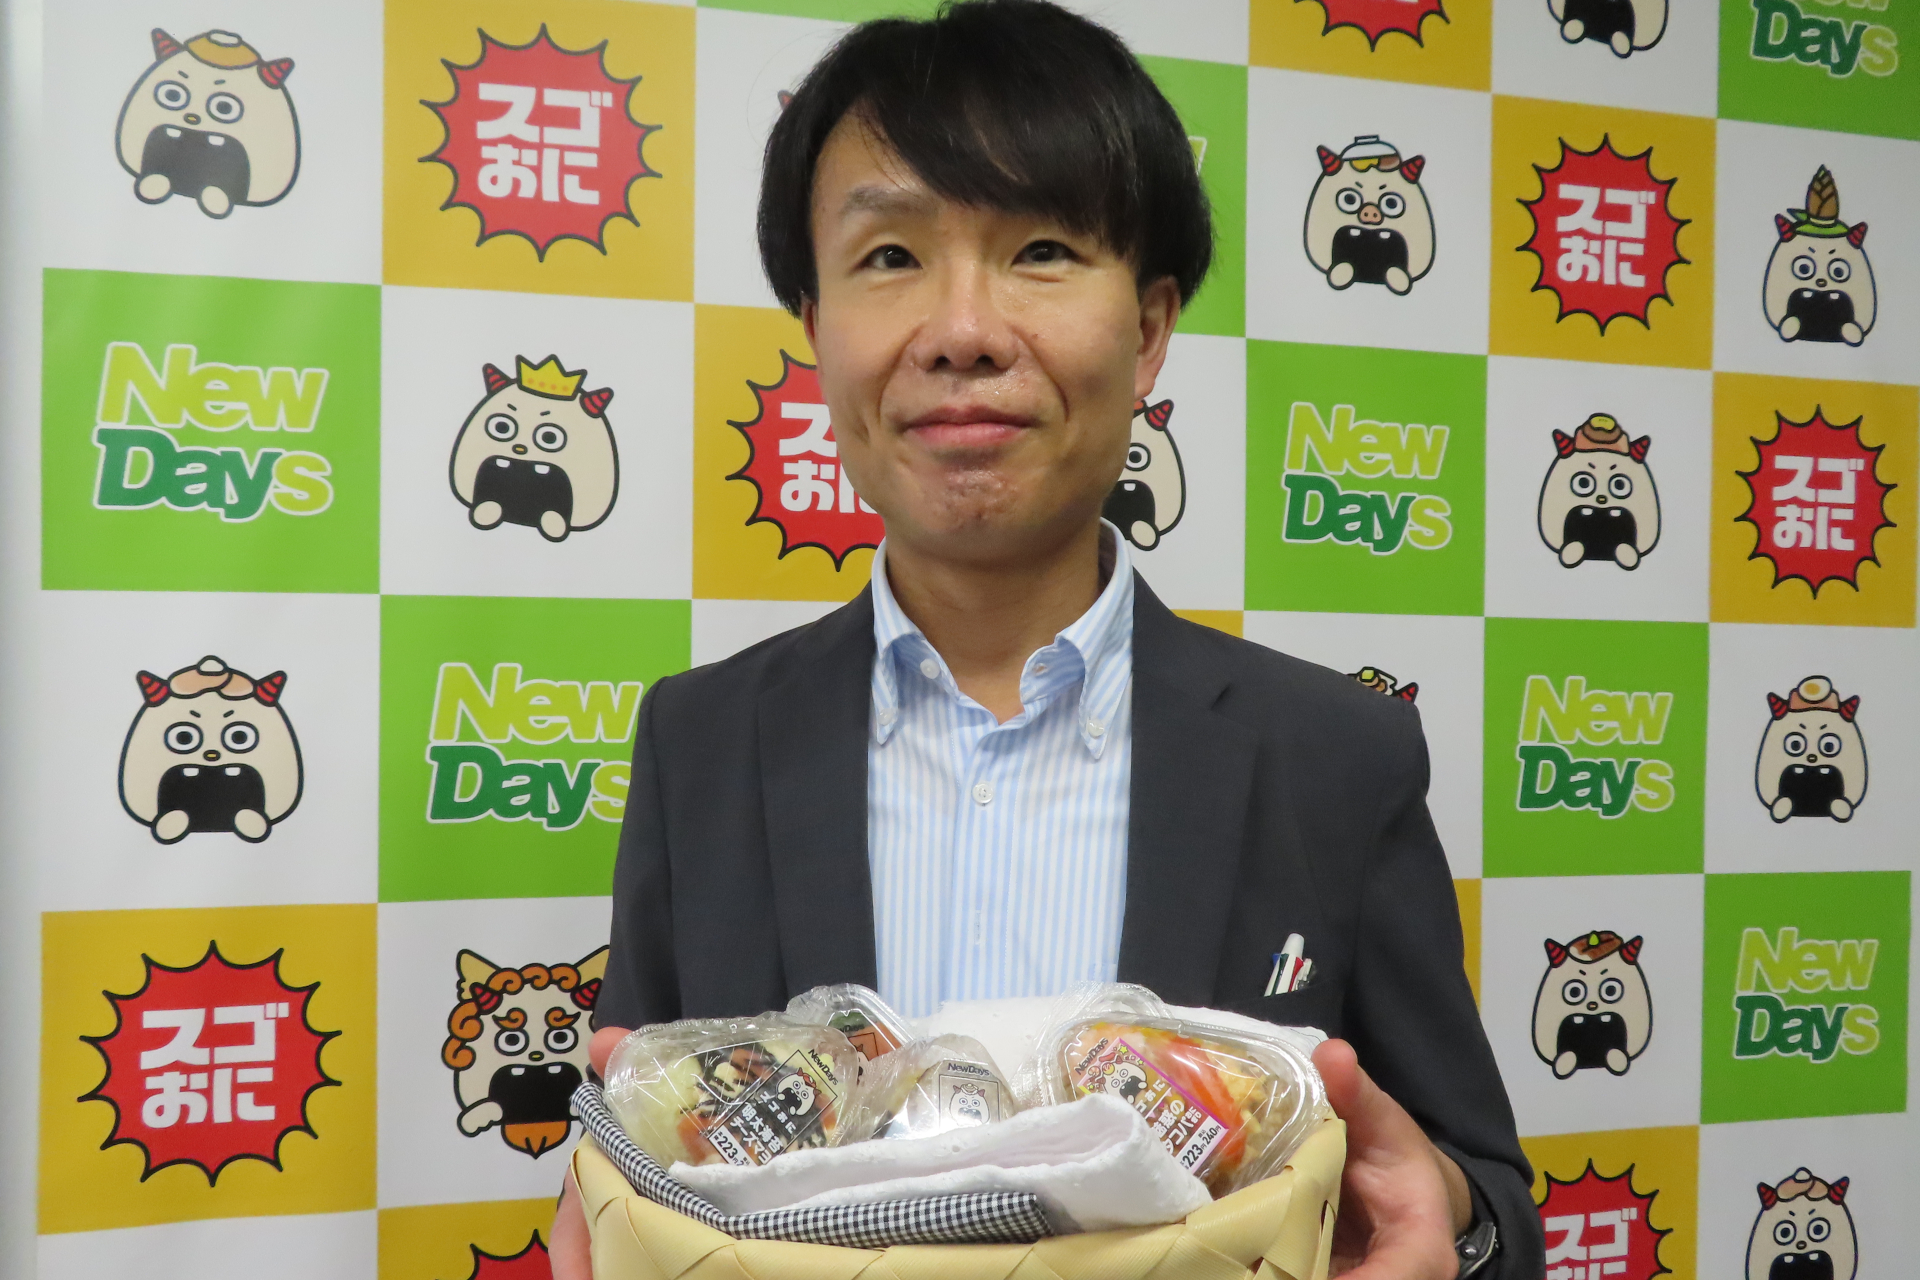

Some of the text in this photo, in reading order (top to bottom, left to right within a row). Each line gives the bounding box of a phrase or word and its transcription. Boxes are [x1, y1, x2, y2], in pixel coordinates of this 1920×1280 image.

[1751, 0, 1898, 78] Days
[477, 83, 613, 148] スゴ
[478, 144, 600, 206] おに
[1557, 184, 1656, 239] スゴ
[1557, 236, 1645, 288] おに
[96, 341, 329, 432] New
[779, 402, 837, 457] ス
[1284, 402, 1449, 479] New
[92, 424, 333, 523] Days
[1773, 455, 1865, 505] スゴ
[1282, 472, 1453, 556] Days
[1772, 505, 1855, 551] おに
[429, 662, 643, 745] New
[1519, 675, 1673, 745] New
[425, 742, 632, 832] Days
[1516, 743, 1675, 819] Days
[1736, 927, 1879, 993] New
[141, 1002, 289, 1070] スゴ
[1074, 1037, 1109, 1075] NewDays
[1733, 994, 1880, 1063] Days
[141, 1067, 275, 1129] おに
[808, 1048, 839, 1086] NewDays
[947, 1061, 991, 1077] NewDays
[1134, 1079, 1166, 1114] ゴおに
[741, 1101, 785, 1155] 明太海苔
[1545, 1207, 1638, 1265] スゴ
